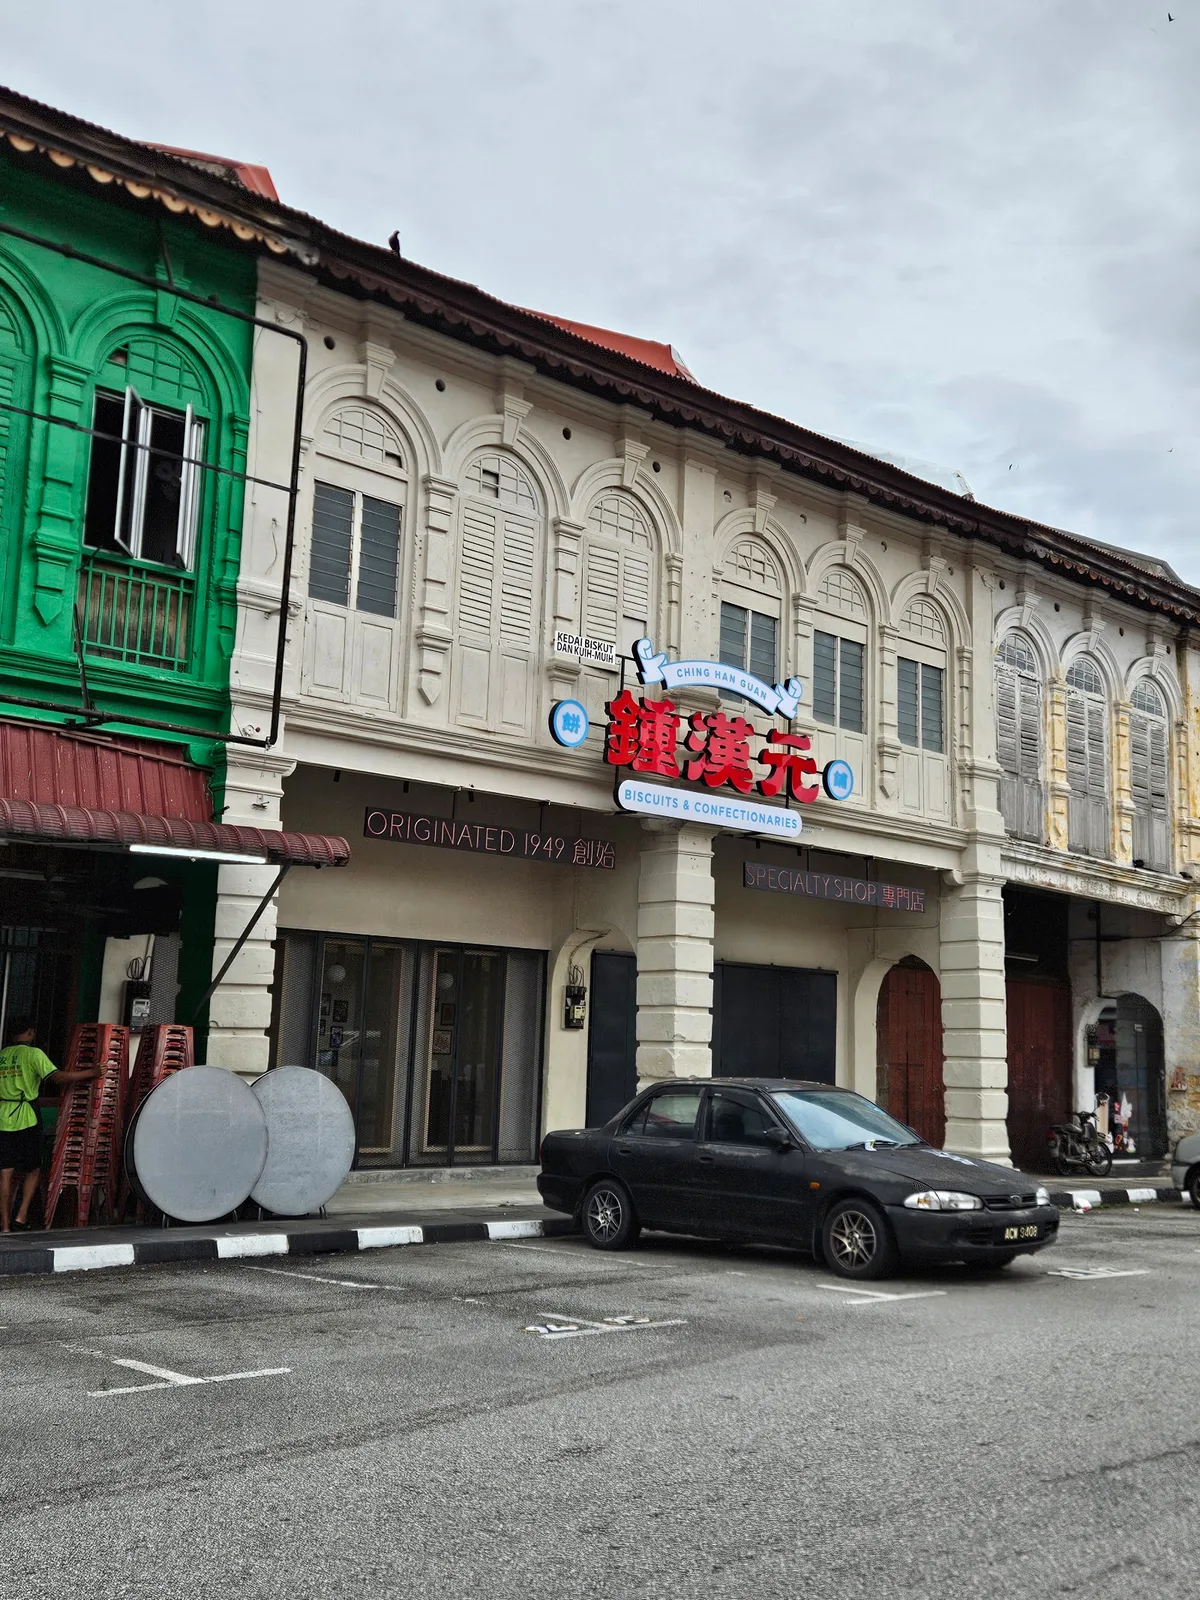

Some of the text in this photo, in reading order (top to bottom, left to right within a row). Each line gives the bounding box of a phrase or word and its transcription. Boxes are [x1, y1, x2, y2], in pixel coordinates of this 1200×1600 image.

[557, 632, 614, 654] KEDAI BISKUT
[557, 642, 614, 664] DAN KUIH-MUIH
[677, 667, 767, 700] CHING HAN GUAN
[624, 789, 679, 809] BISCUITS
[683, 800, 690, 811] &
[694, 802, 798, 829] CONFECTIONARIES
[367, 811, 616, 869] ORIGINATED 1949 創始
[745, 865, 925, 912] SPECIALTY SHOP 專門店
